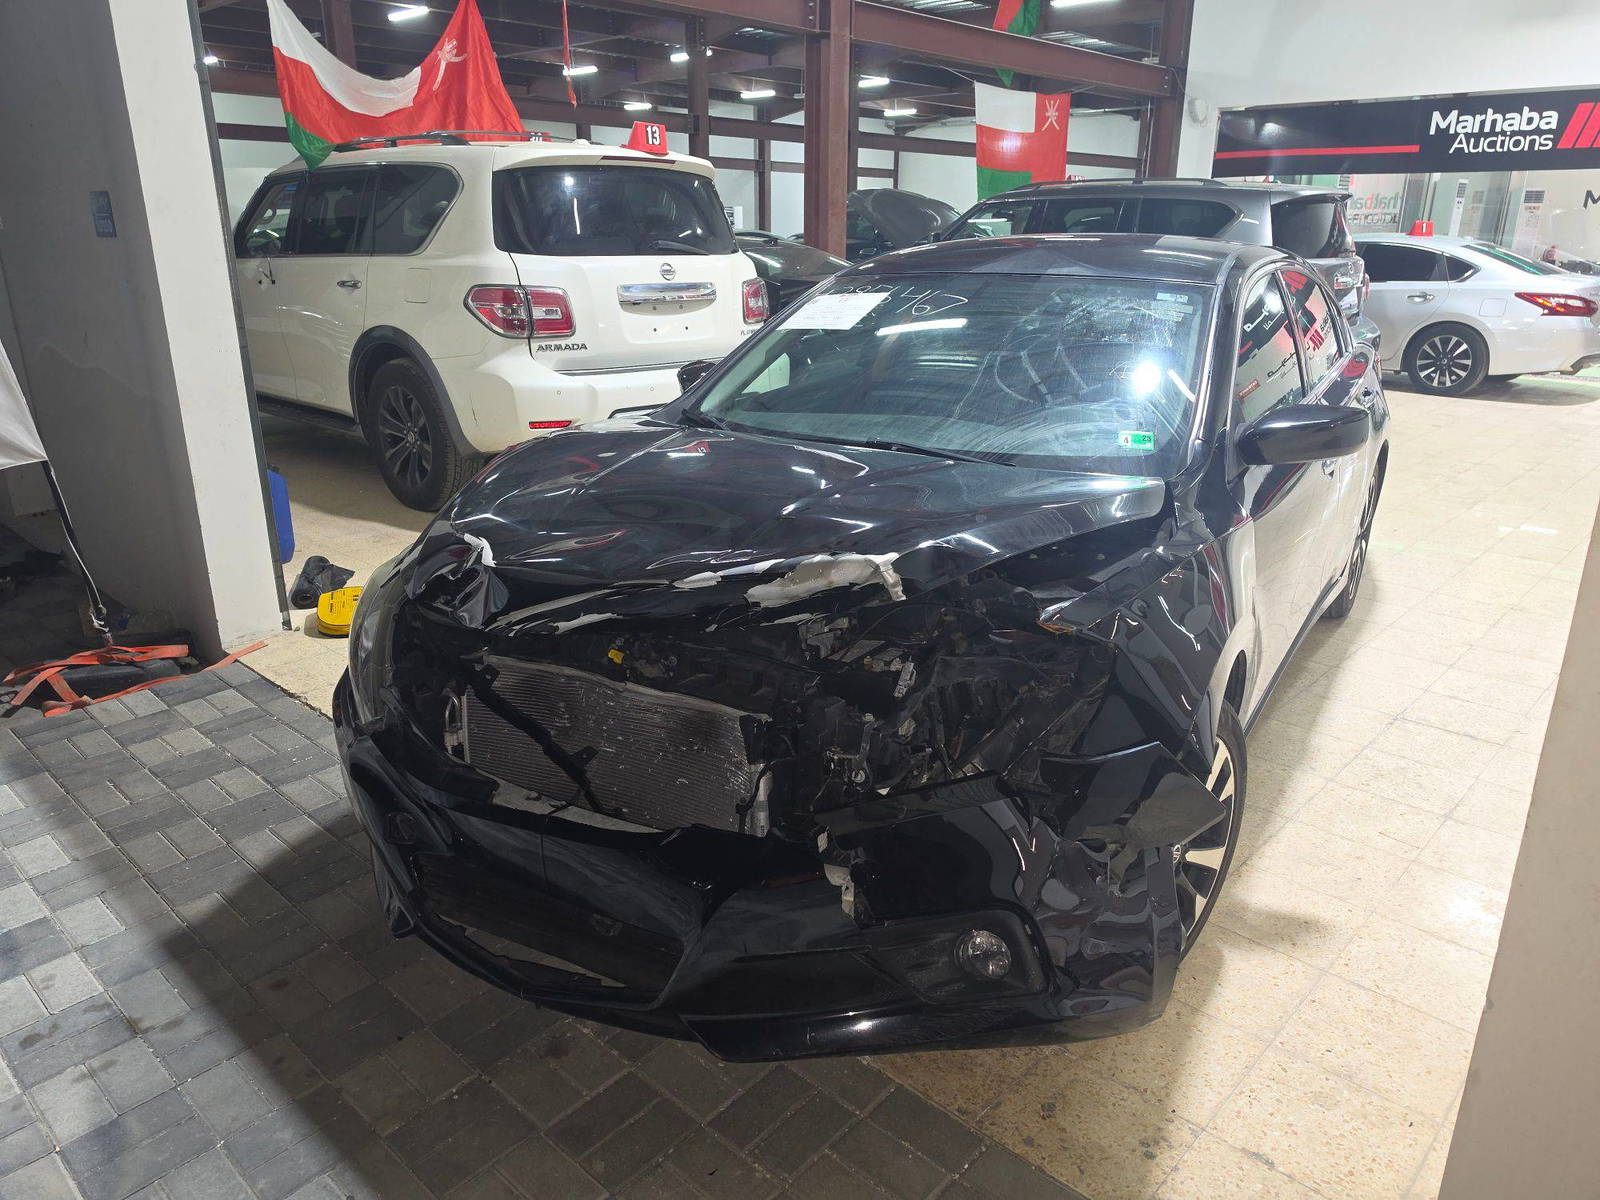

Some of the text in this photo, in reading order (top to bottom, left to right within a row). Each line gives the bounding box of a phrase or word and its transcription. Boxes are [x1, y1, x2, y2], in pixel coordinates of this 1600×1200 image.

[1429, 106, 1558, 135] Marhaba
[646, 126, 661, 145] 13
[1449, 131, 1554, 154] Auctions
[536, 343, 588, 352] ARMADA
